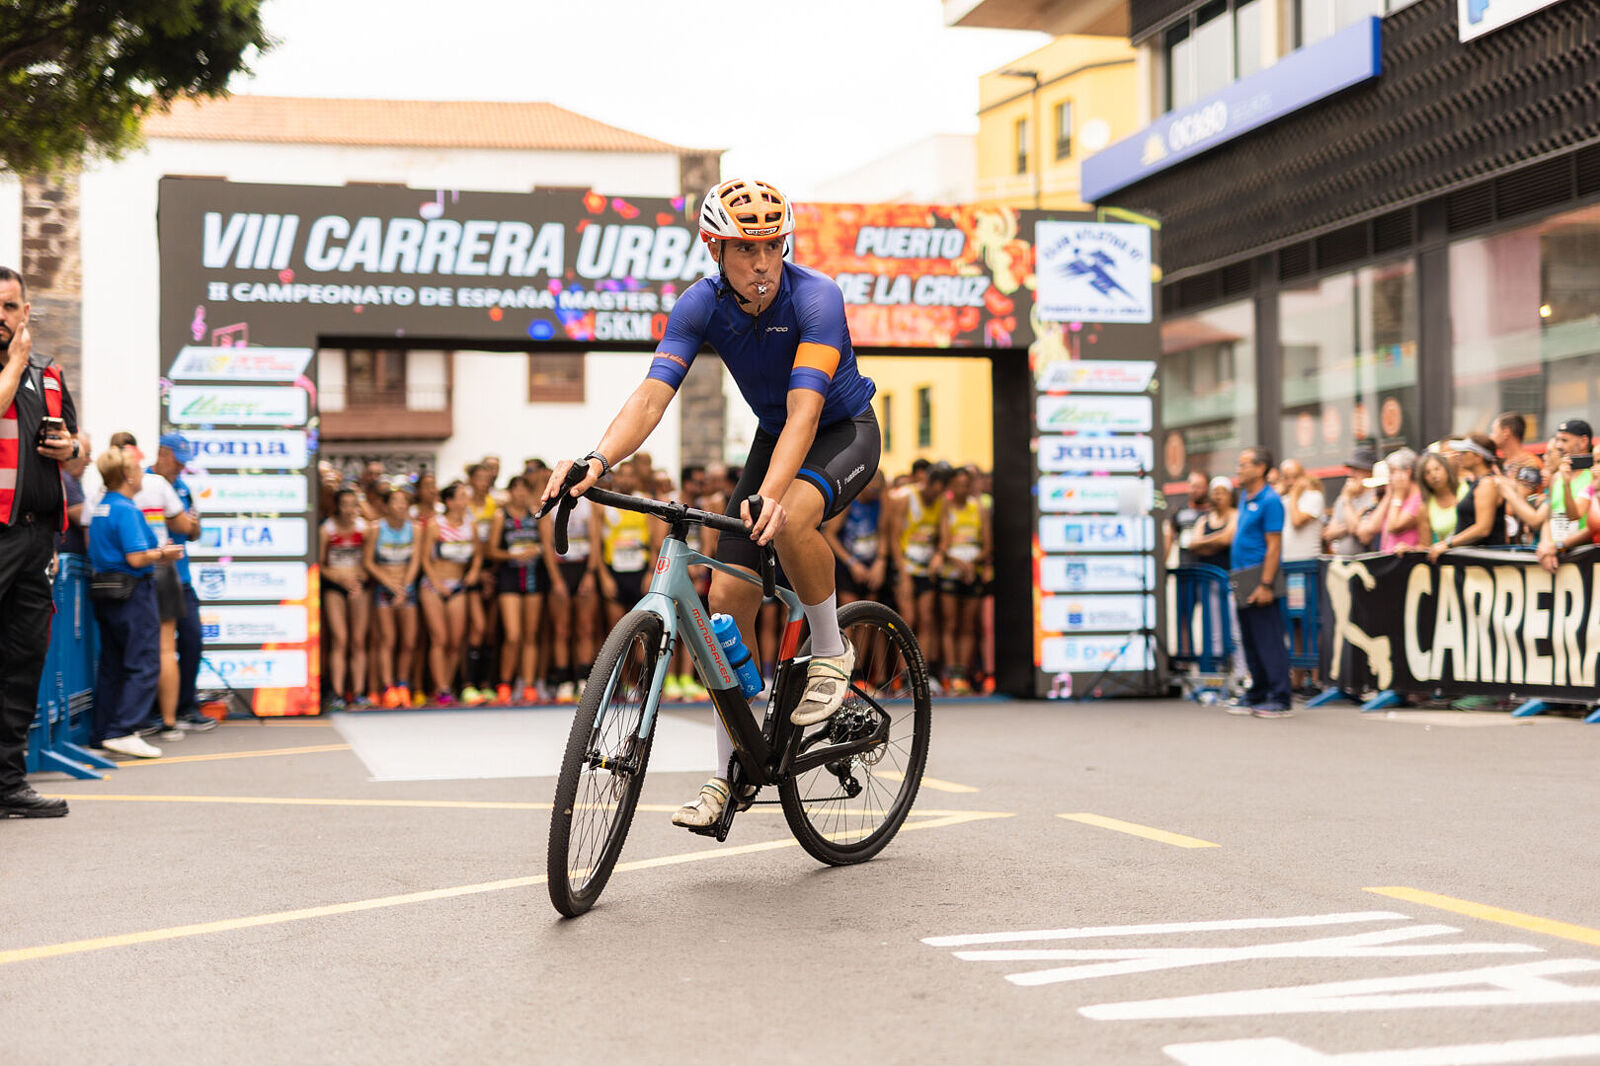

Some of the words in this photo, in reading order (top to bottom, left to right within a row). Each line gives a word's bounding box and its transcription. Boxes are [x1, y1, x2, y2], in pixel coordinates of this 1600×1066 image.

[203, 212, 299, 270] VIII
[304, 215, 565, 277] CARRERA
[576, 224, 719, 281] URBA
[855, 226, 966, 259] PUERTO
[207, 281, 229, 301] II
[232, 283, 416, 306] CAMPEONATO
[418, 286, 454, 307] DE
[457, 286, 556, 310] ESPAÑA
[559, 289, 659, 312] MASTER
[834, 272, 874, 304] DE
[873, 273, 912, 305] LA
[914, 274, 991, 307] CRUZ
[227, 526, 274, 544] FCA
[1089, 523, 1127, 542] FCA
